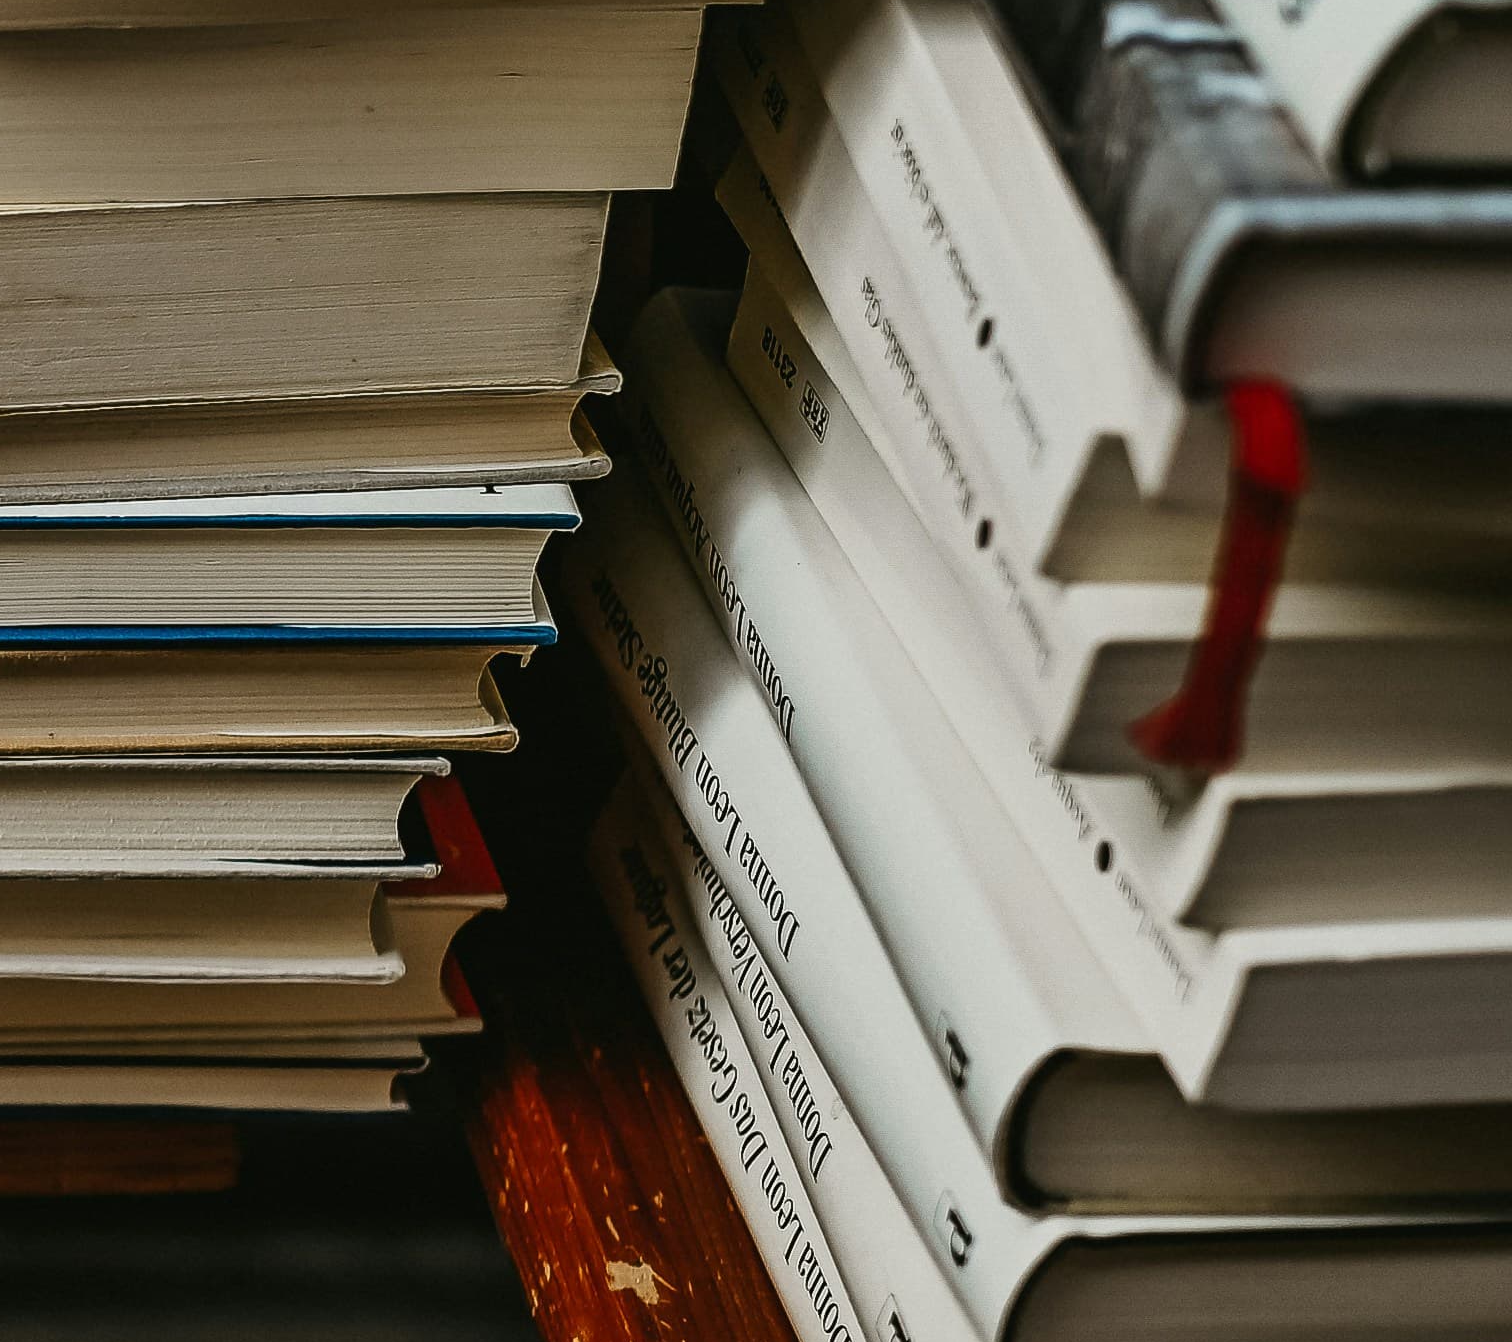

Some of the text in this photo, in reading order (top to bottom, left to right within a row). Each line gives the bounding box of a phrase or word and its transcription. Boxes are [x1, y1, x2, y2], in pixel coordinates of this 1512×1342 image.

[761, 325, 797, 391] 23118
[705, 542, 748, 649] Leon
[636, 652, 699, 773] Blutige
[745, 618, 797, 749] Donna
[695, 749, 744, 858] Leon
[738, 831, 802, 964] Donna
[666, 938, 697, 1002] der
[748, 969, 789, 1074] Leon
[686, 995, 741, 1105] Gesetz
[728, 1098, 770, 1175] Das
[783, 1051, 834, 1184] Donna
[760, 1157, 806, 1267] Leon
